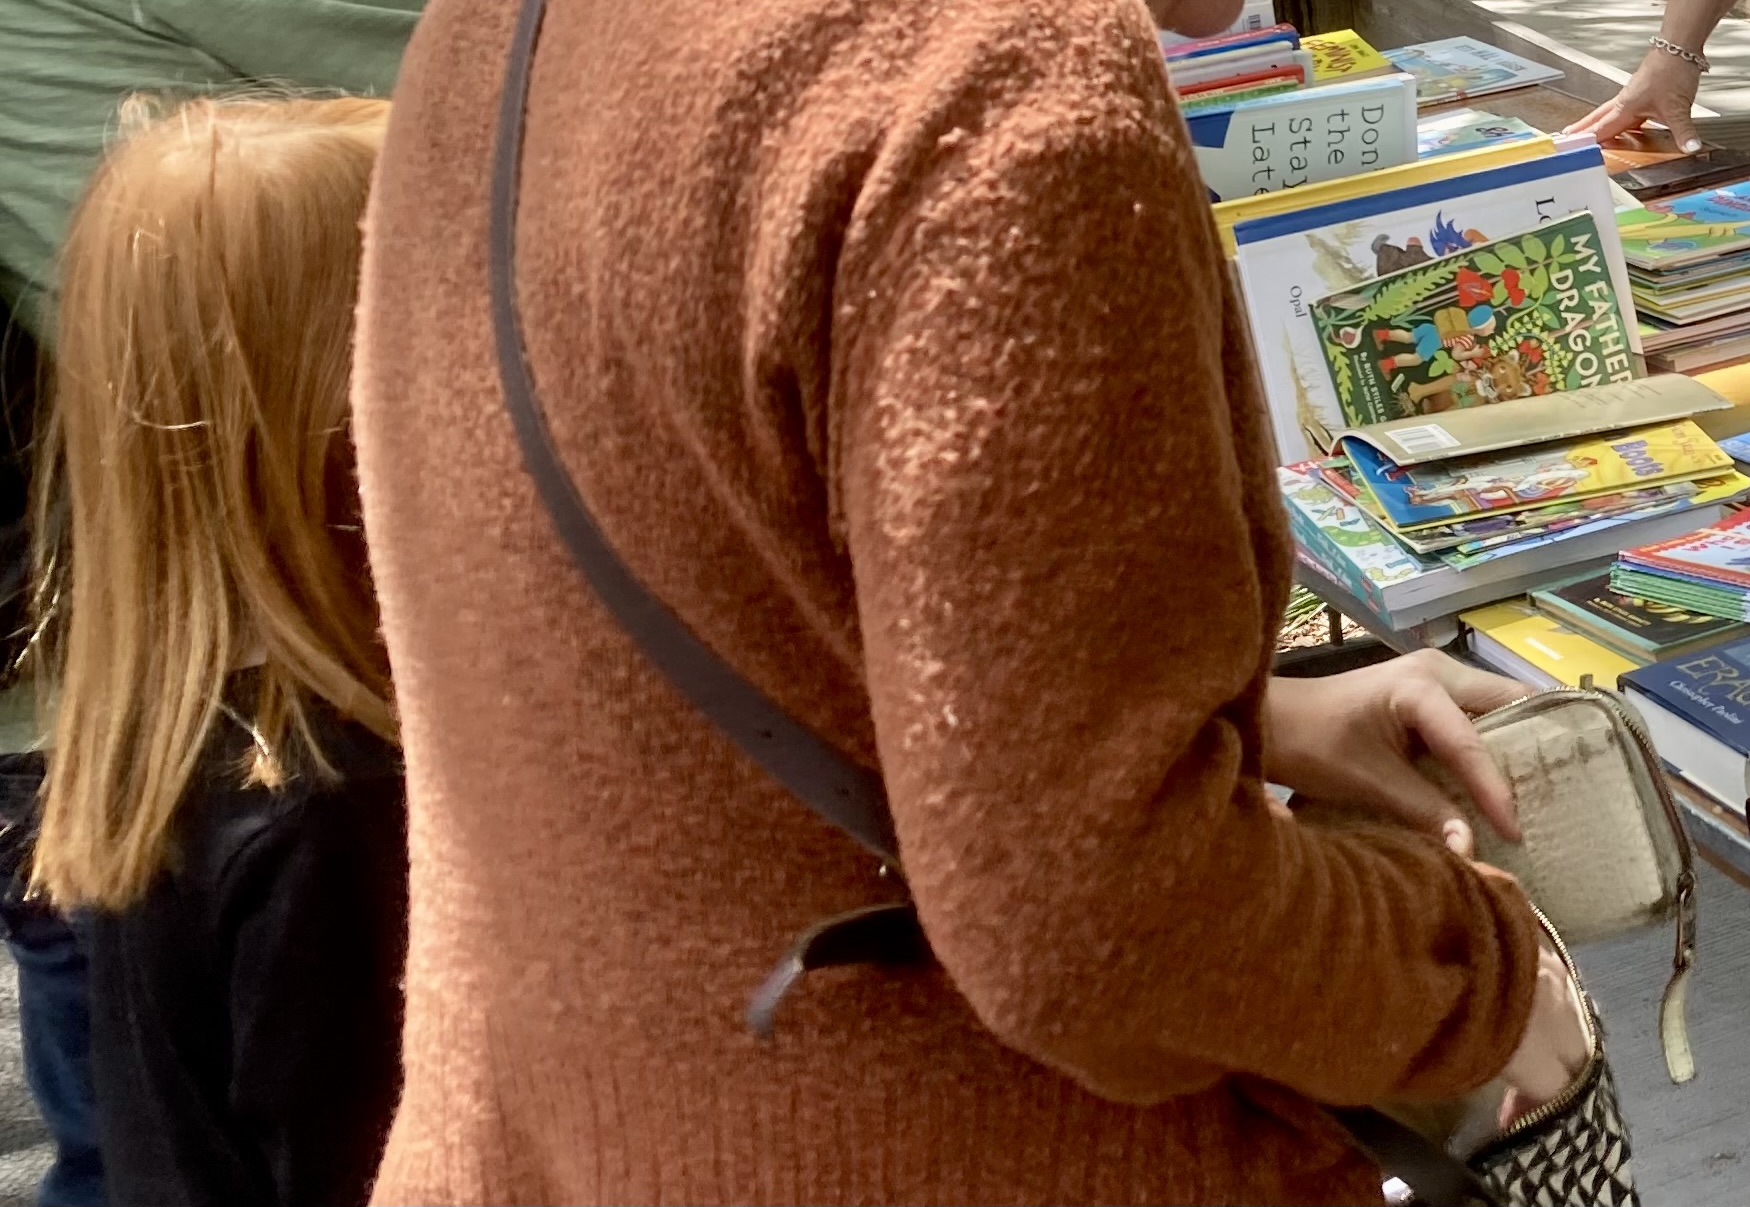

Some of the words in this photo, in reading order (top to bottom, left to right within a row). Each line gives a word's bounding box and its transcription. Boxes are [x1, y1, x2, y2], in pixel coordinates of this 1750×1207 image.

[1327, 108, 1349, 165] the
[1570, 233, 1602, 273] MY
[1290, 285, 1308, 318] Opal
